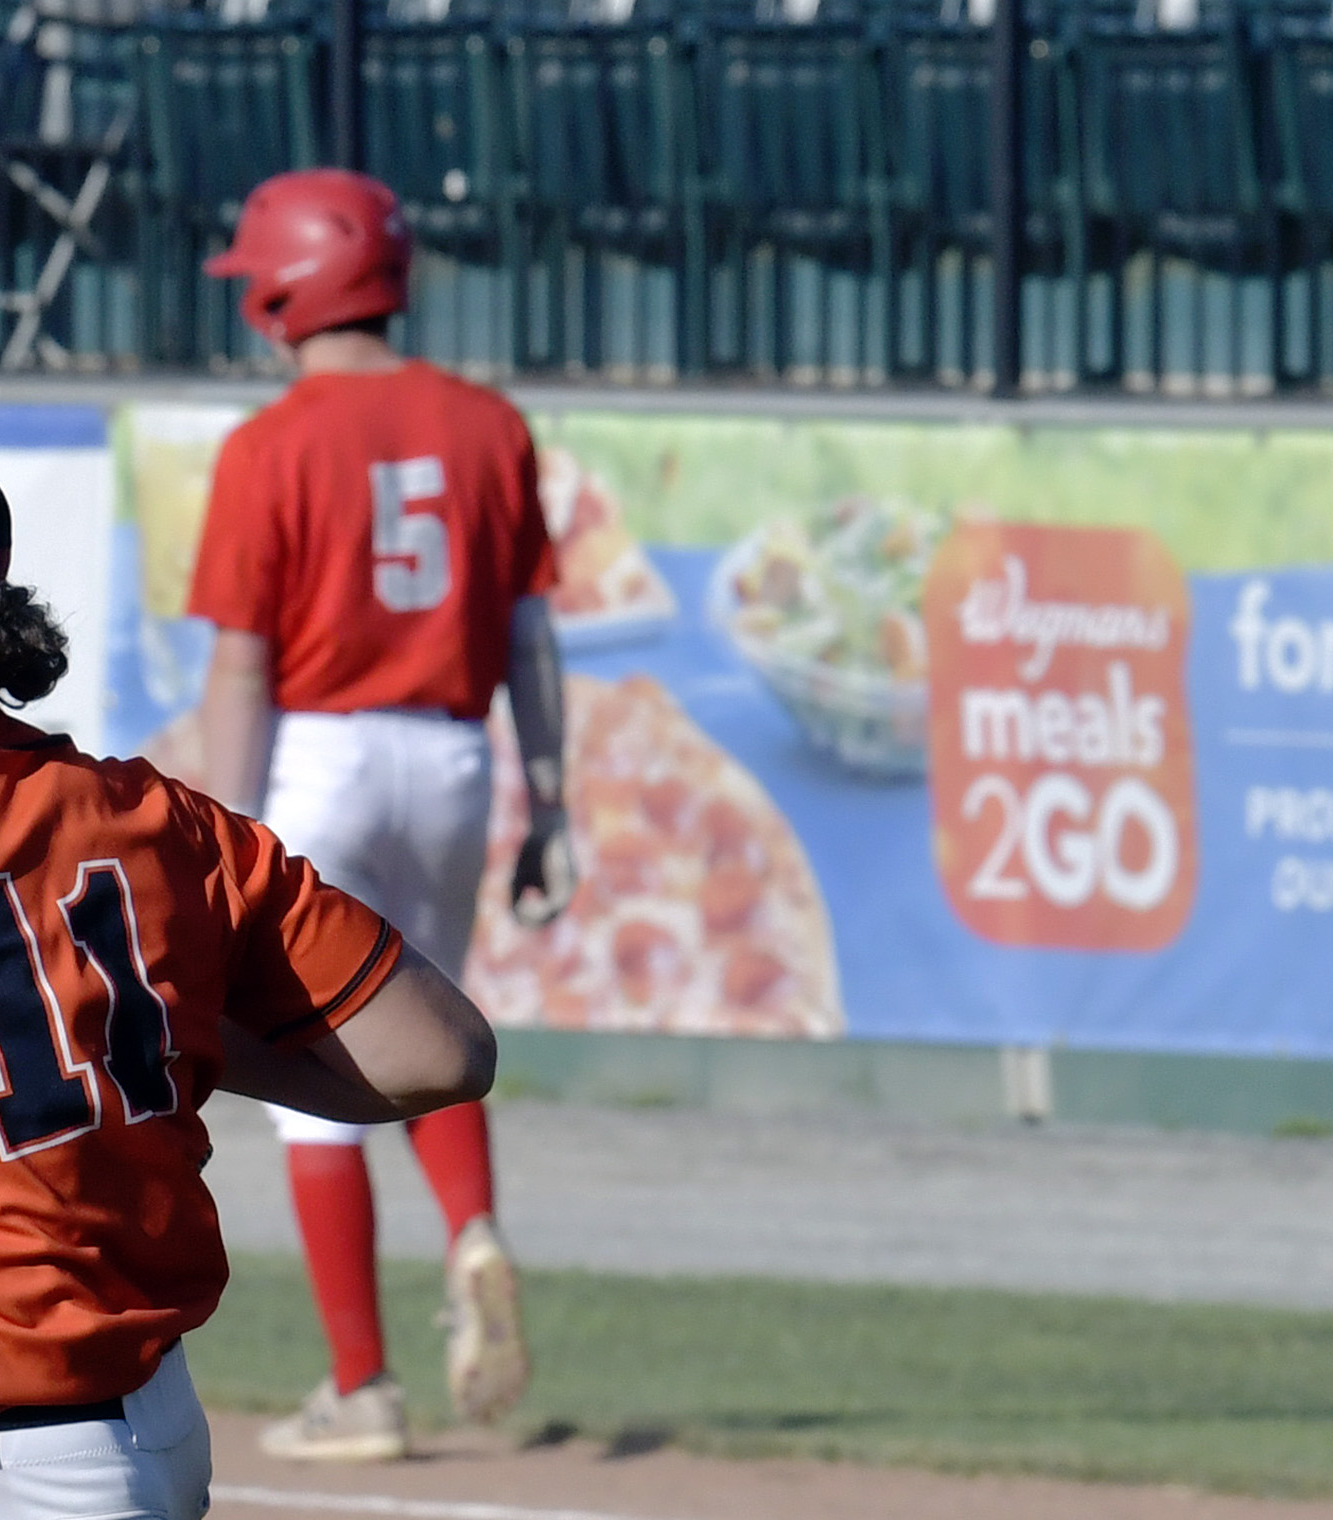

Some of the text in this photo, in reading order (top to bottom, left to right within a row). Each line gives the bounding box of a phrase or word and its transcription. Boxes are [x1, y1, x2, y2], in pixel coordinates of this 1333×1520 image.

[370, 457, 452, 613] 5
[960, 658, 1169, 769] meals
[960, 772, 1181, 913] 2GO
